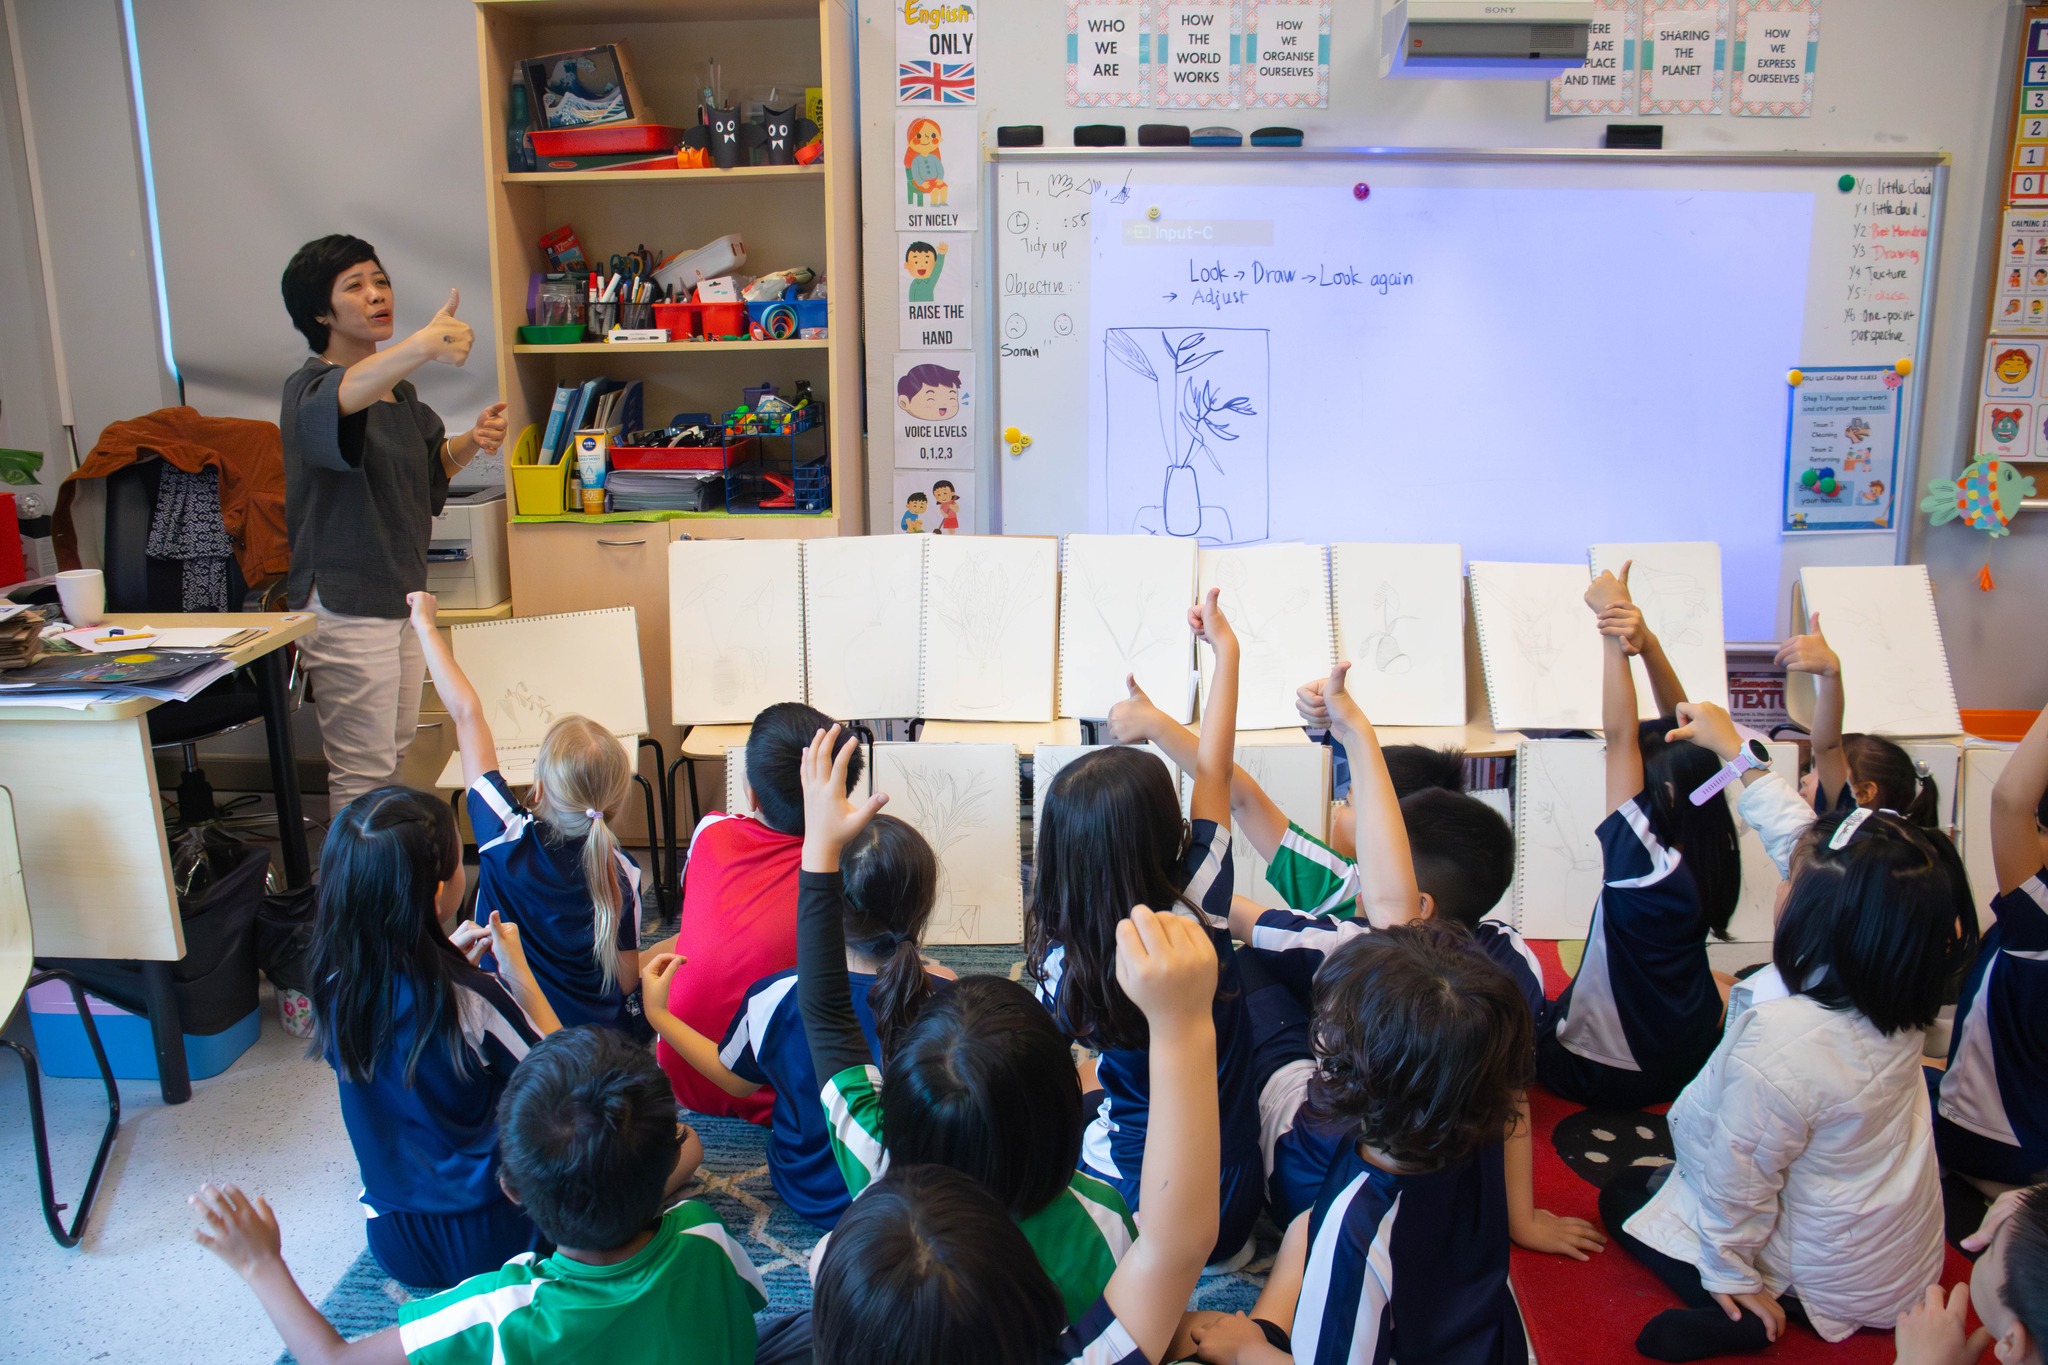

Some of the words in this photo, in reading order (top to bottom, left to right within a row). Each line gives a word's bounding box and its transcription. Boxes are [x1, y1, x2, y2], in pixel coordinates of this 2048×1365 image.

[905, 0, 968, 29] English
[1181, 14, 1213, 27] HOW
[1088, 19, 1125, 33] WHO
[1276, 20, 1303, 30] HOW
[1588, 24, 1611, 34] HERE
[1188, 33, 1209, 45] THE
[1660, 30, 1710, 42] SHARING
[1765, 29, 1790, 39] HOW
[930, 33, 973, 54] ONLY
[1281, 36, 1297, 46] WE
[1593, 41, 1614, 51] ARE
[1095, 42, 1117, 55] WE
[1674, 48, 1694, 59] THE
[1770, 44, 1786, 54] WE
[1176, 52, 1221, 65] WORLD
[1262, 51, 1315, 62] ORGANISE
[1584, 58, 1616, 68] PLACE
[1093, 63, 1119, 77] ARE
[1662, 65, 1701, 76] PLANET
[1757, 59, 1796, 69] EXPRESS
[1174, 71, 1220, 84] WORKS
[1259, 66, 1314, 78] OURSELVES
[1748, 73, 1800, 84] OURSELVES
[2037, 65, 2047, 79] 4
[1564, 75, 1588, 86] AND
[1592, 75, 1616, 86] TIME
[2035, 90, 2043, 108] 3
[2031, 121, 2041, 136] 2
[2026, 150, 2035, 164] 1
[1878, 178, 1907, 195] little
[1909, 179, 1931, 195] cloud
[2023, 177, 2032, 191] 0
[1873, 201, 1895, 216] little
[908, 214, 923, 227] SIT
[926, 214, 958, 227] NICELY
[1155, 225, 1213, 241] Input-C
[1853, 224, 1867, 239] Y2
[1021, 237, 1047, 259] Tidy
[1053, 240, 1067, 259] up
[1852, 244, 1866, 259] Y3
[1872, 245, 1919, 264] Drawing
[1190, 258, 1229, 283] Look
[1253, 260, 1296, 285] Draw
[1320, 264, 1363, 287] Look
[1370, 272, 1413, 295] again
[1850, 266, 1861, 280] Y4
[1866, 266, 1908, 280] Texture
[1192, 288, 1248, 310] Adjust
[909, 305, 940, 319] RAISE
[944, 305, 964, 319] THE
[1862, 309, 1915, 325] One-point
[922, 331, 953, 345] HAND
[1851, 329, 1905, 346] perspective
[1001, 344, 1039, 358] Somin
[905, 426, 931, 438] VOICE
[934, 426, 967, 438] LEVELS
[920, 447, 953, 460] 0,1,2,3
[1809, 456, 1840, 464] Returning
[1801, 497, 1818, 505] your
